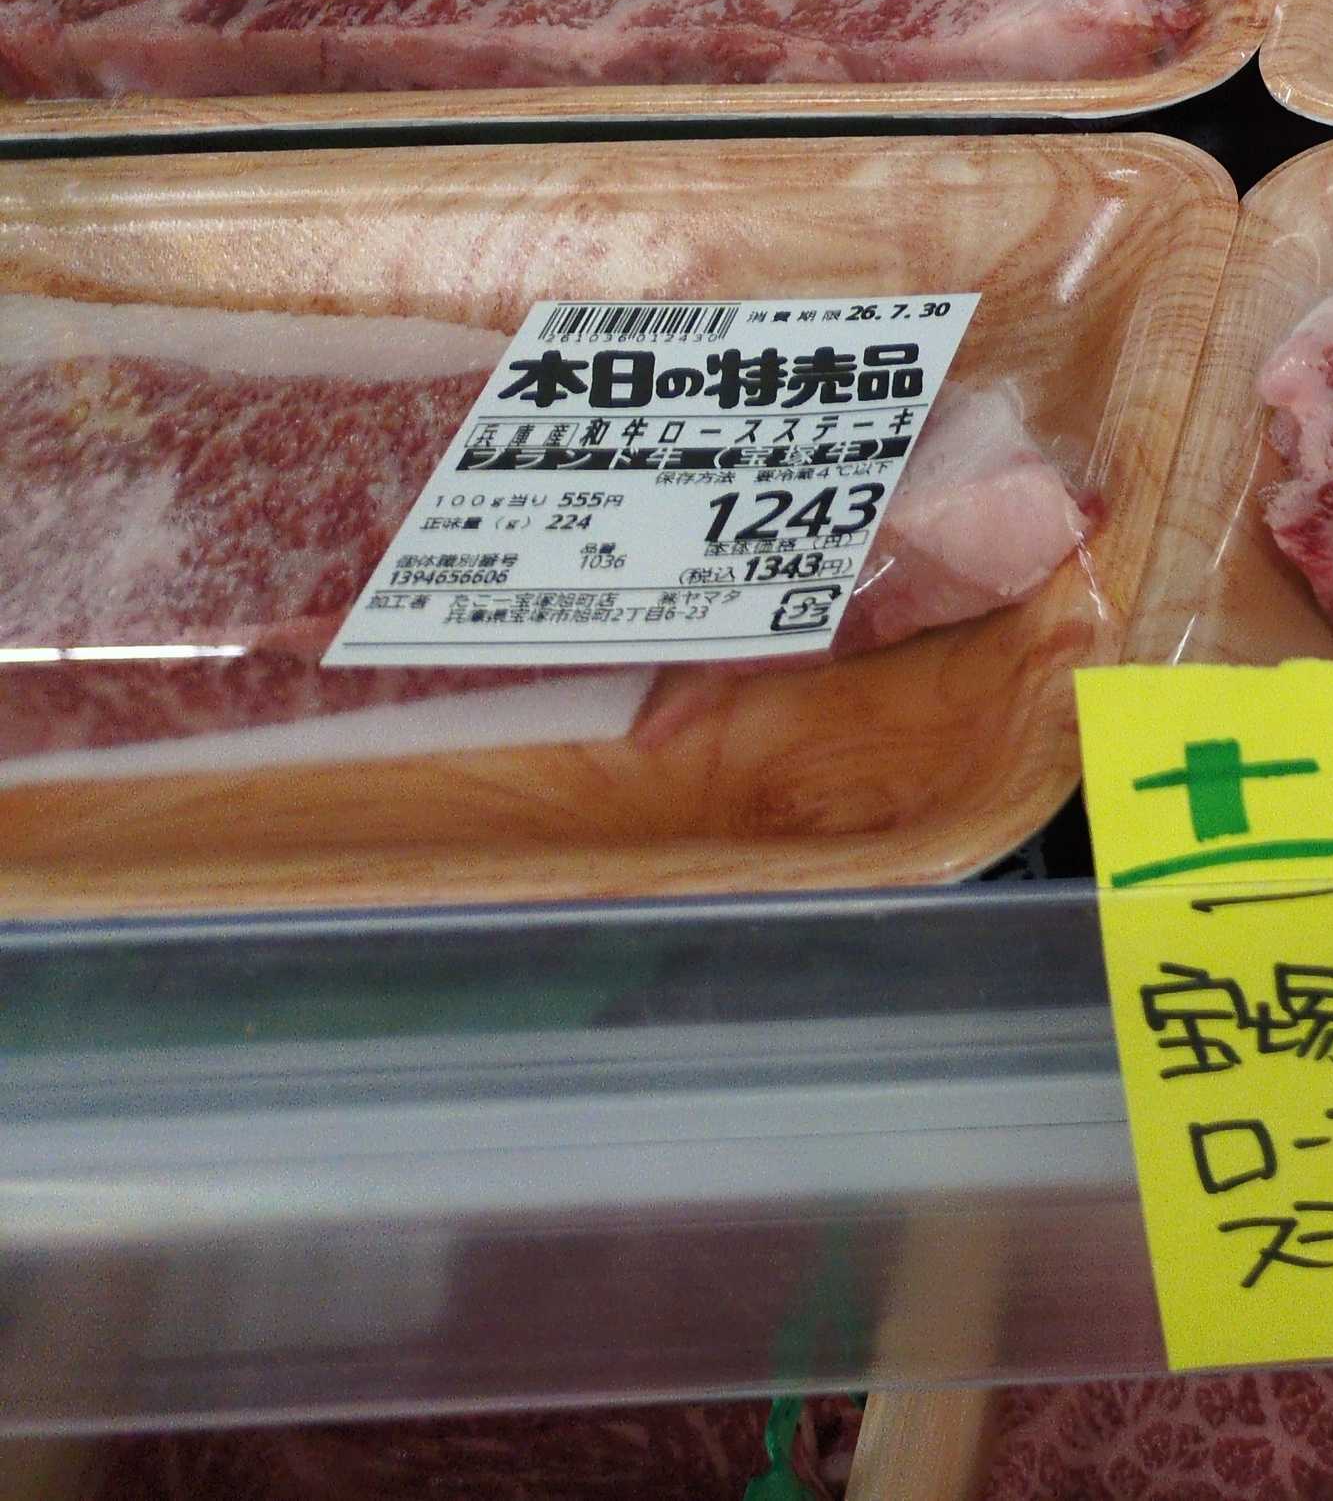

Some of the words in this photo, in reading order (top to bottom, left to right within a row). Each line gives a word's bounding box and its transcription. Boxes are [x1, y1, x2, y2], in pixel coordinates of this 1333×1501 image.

[845, 302, 952, 322] 26.7.30
[546, 333, 719, 344] 261036012430
[497, 343, 924, 409] 本日の特売品
[557, 491, 624, 509] 555円
[704, 482, 885, 542] 1243
[544, 513, 593, 531] 224
[580, 554, 626, 570] 1036
[389, 569, 510, 586] 1394656606
